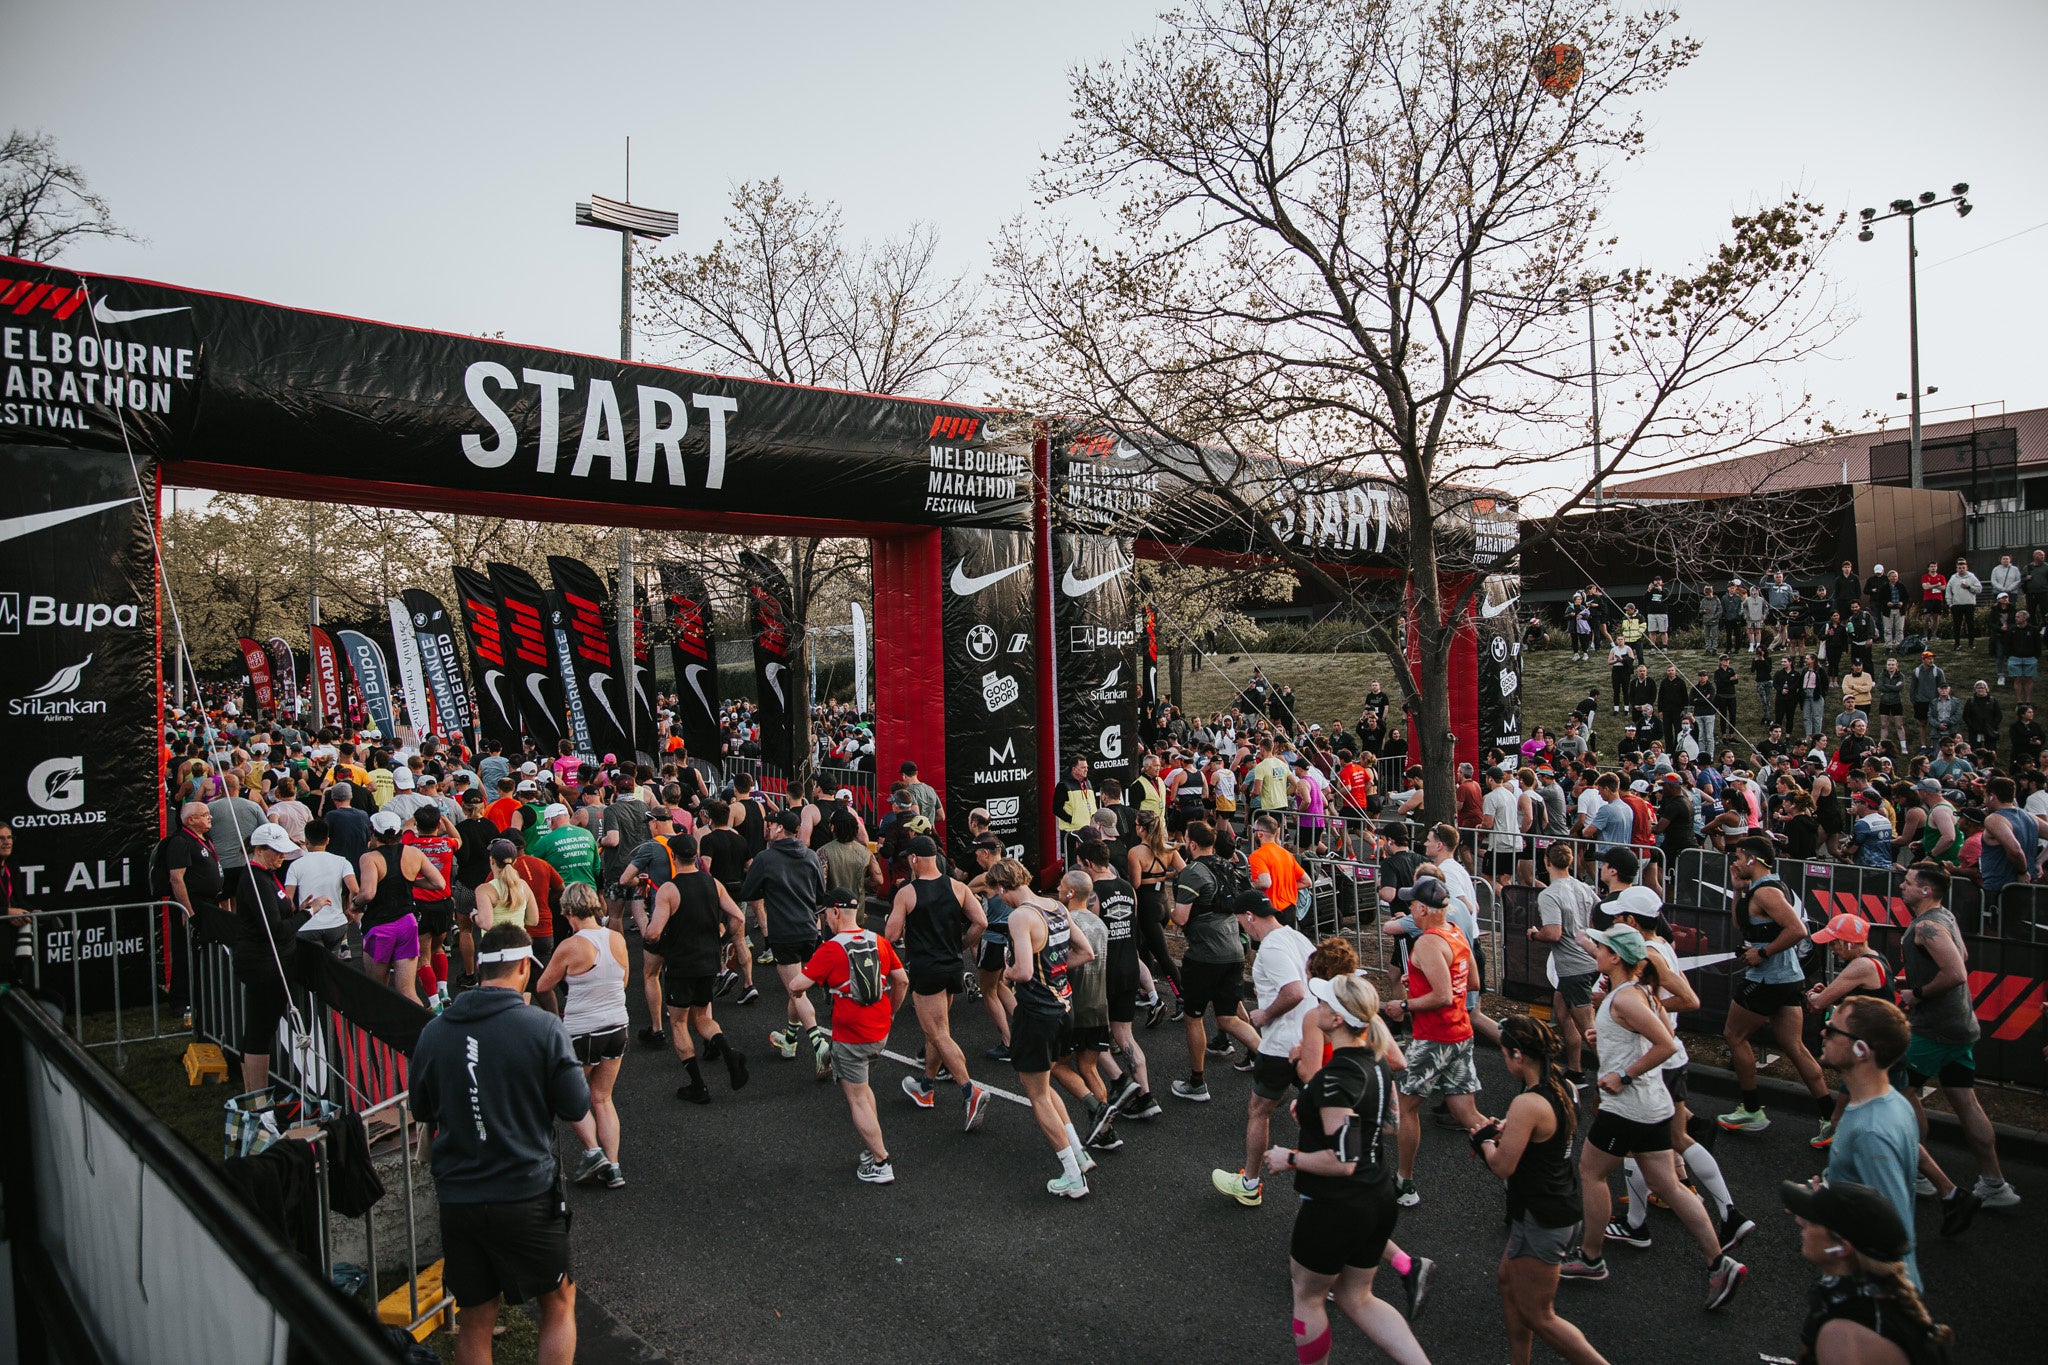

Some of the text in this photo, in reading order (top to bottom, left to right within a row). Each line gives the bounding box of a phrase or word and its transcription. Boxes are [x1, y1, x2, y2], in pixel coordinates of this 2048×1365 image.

[461, 361, 738, 490] START
[930, 445, 1025, 476] MELBOURNE
[928, 471, 1016, 499] MARATHON
[925, 497, 978, 514] FESTIVAL
[1271, 477, 1390, 553] START
[26, 596, 138, 632] Bupa
[1096, 627, 1134, 646] Bupa
[357, 645, 380, 694] Bupa
[438, 633, 470, 727] REDEFINED
[557, 633, 591, 751] PERFORMANCE
[986, 679, 1013, 698] GOOD
[989, 686, 1016, 708] SPORT
[1091, 689, 1127, 700] SriLankan
[8, 698, 107, 715] SriLankan
[1094, 759, 1129, 769] GATORADE
[974, 768, 1027, 784] MAURTEN
[12, 811, 107, 828] GATORADE
[563, 850, 588, 858] SPARTAN
[86, 927, 105, 943] OF
[47, 937, 144, 964] MEBOURNE
[469, 1087, 482, 1119] 2022
